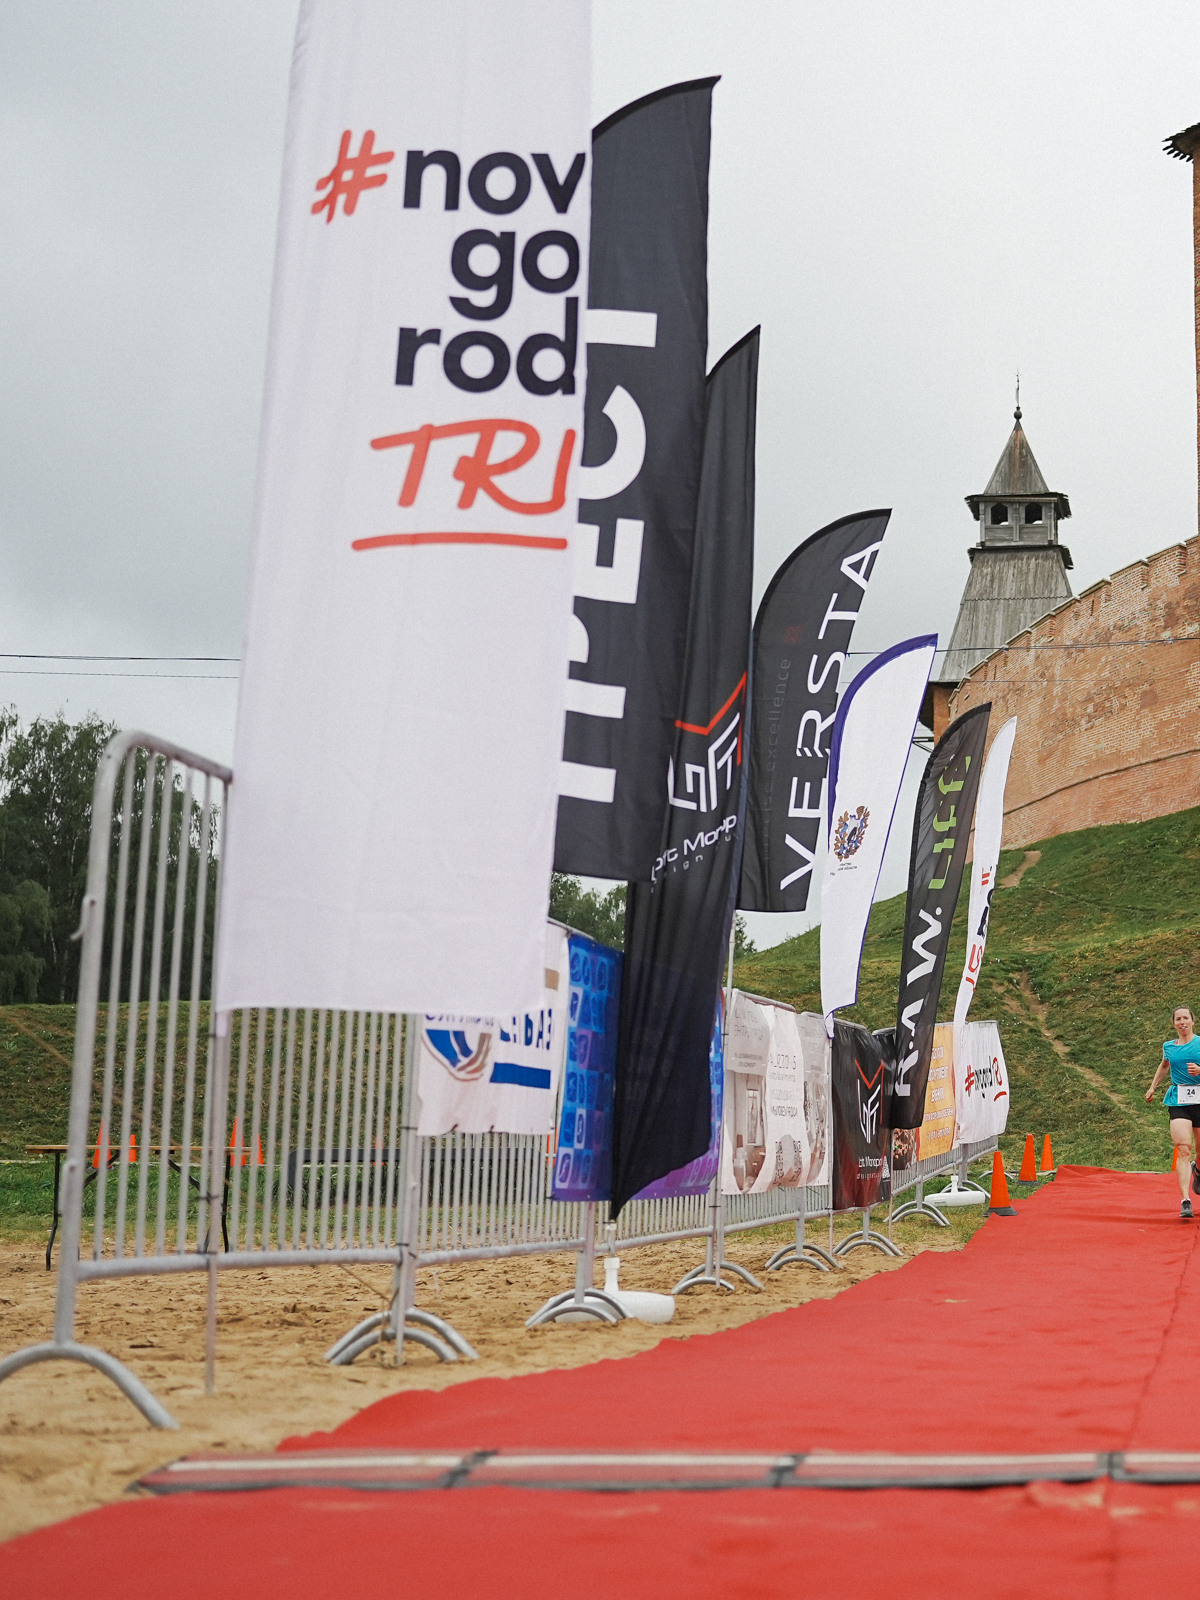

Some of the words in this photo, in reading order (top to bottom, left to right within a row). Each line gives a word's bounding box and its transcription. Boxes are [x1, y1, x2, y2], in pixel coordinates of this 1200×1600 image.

[311, 129, 587, 224] #nov
[449, 228, 580, 321] go
[394, 296, 580, 396] rod
[370, 418, 577, 516] TRI
[779, 539, 884, 891] VERSTA
[1186, 1088, 1196, 1096] 24
